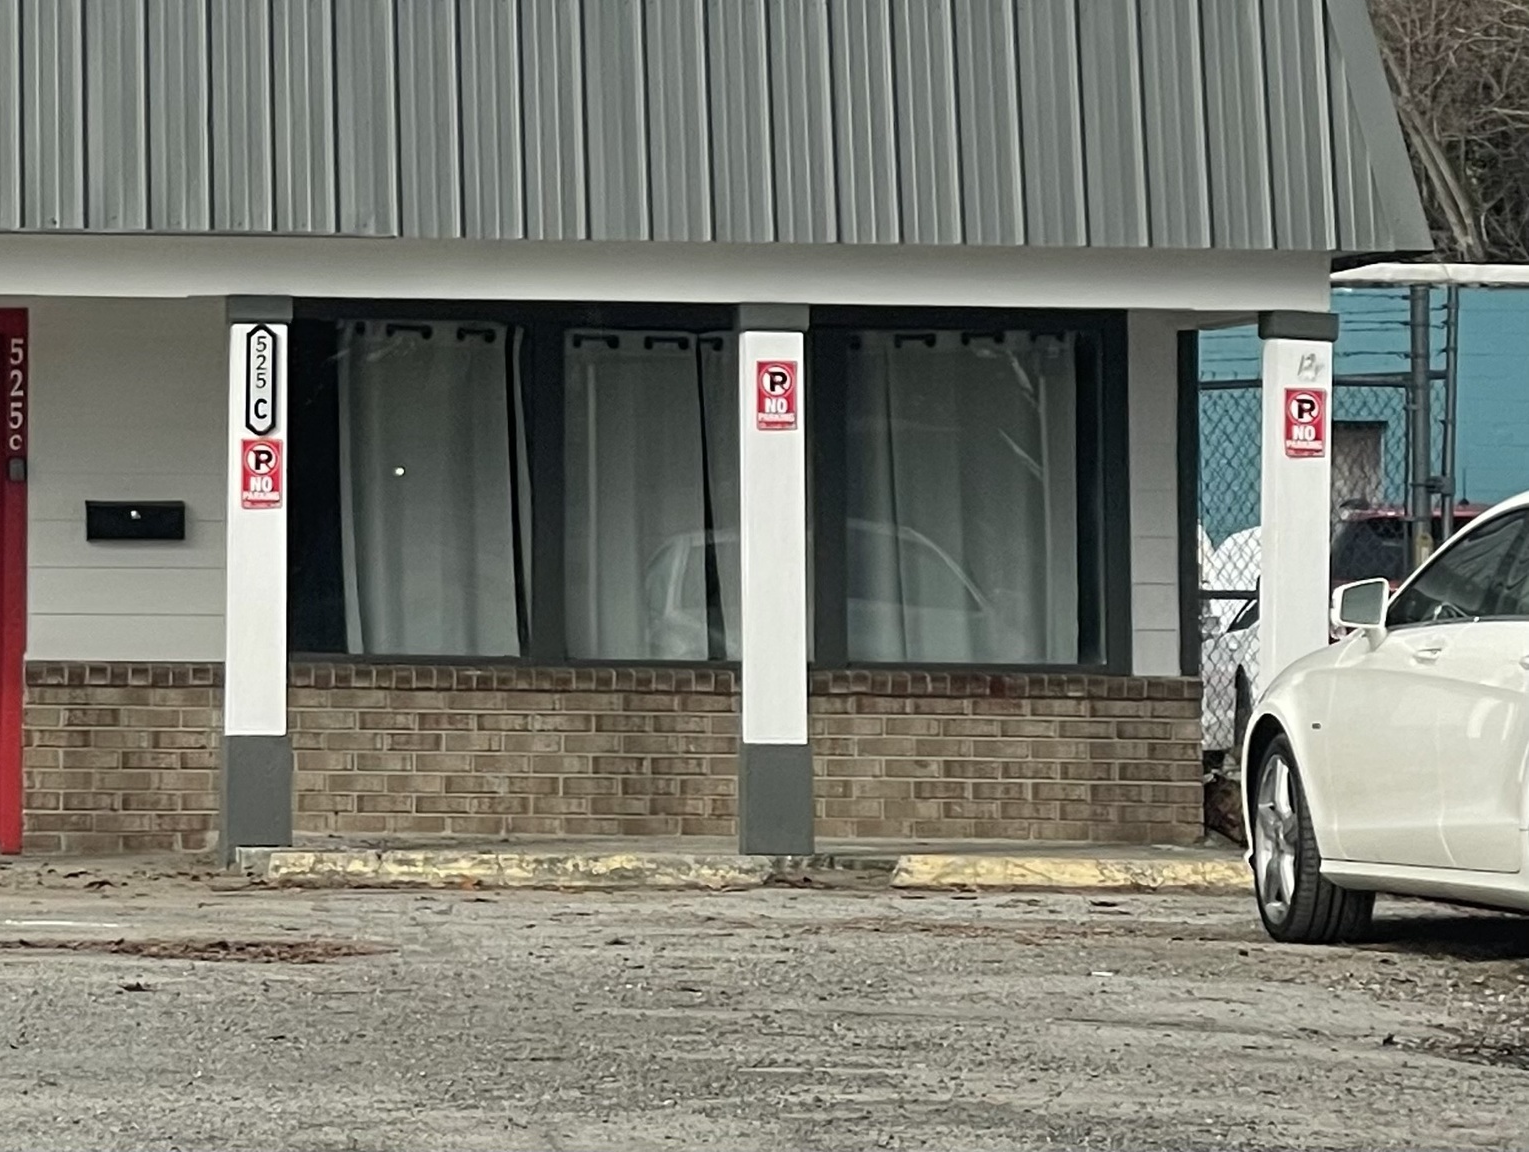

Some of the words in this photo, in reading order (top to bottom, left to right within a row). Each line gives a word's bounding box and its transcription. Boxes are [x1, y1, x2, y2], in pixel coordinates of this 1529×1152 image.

[255, 335, 268, 389] 525
[254, 398, 268, 419] C
[764, 397, 789, 414] NO
[1293, 425, 1316, 441] NO
[250, 476, 273, 493] NO
